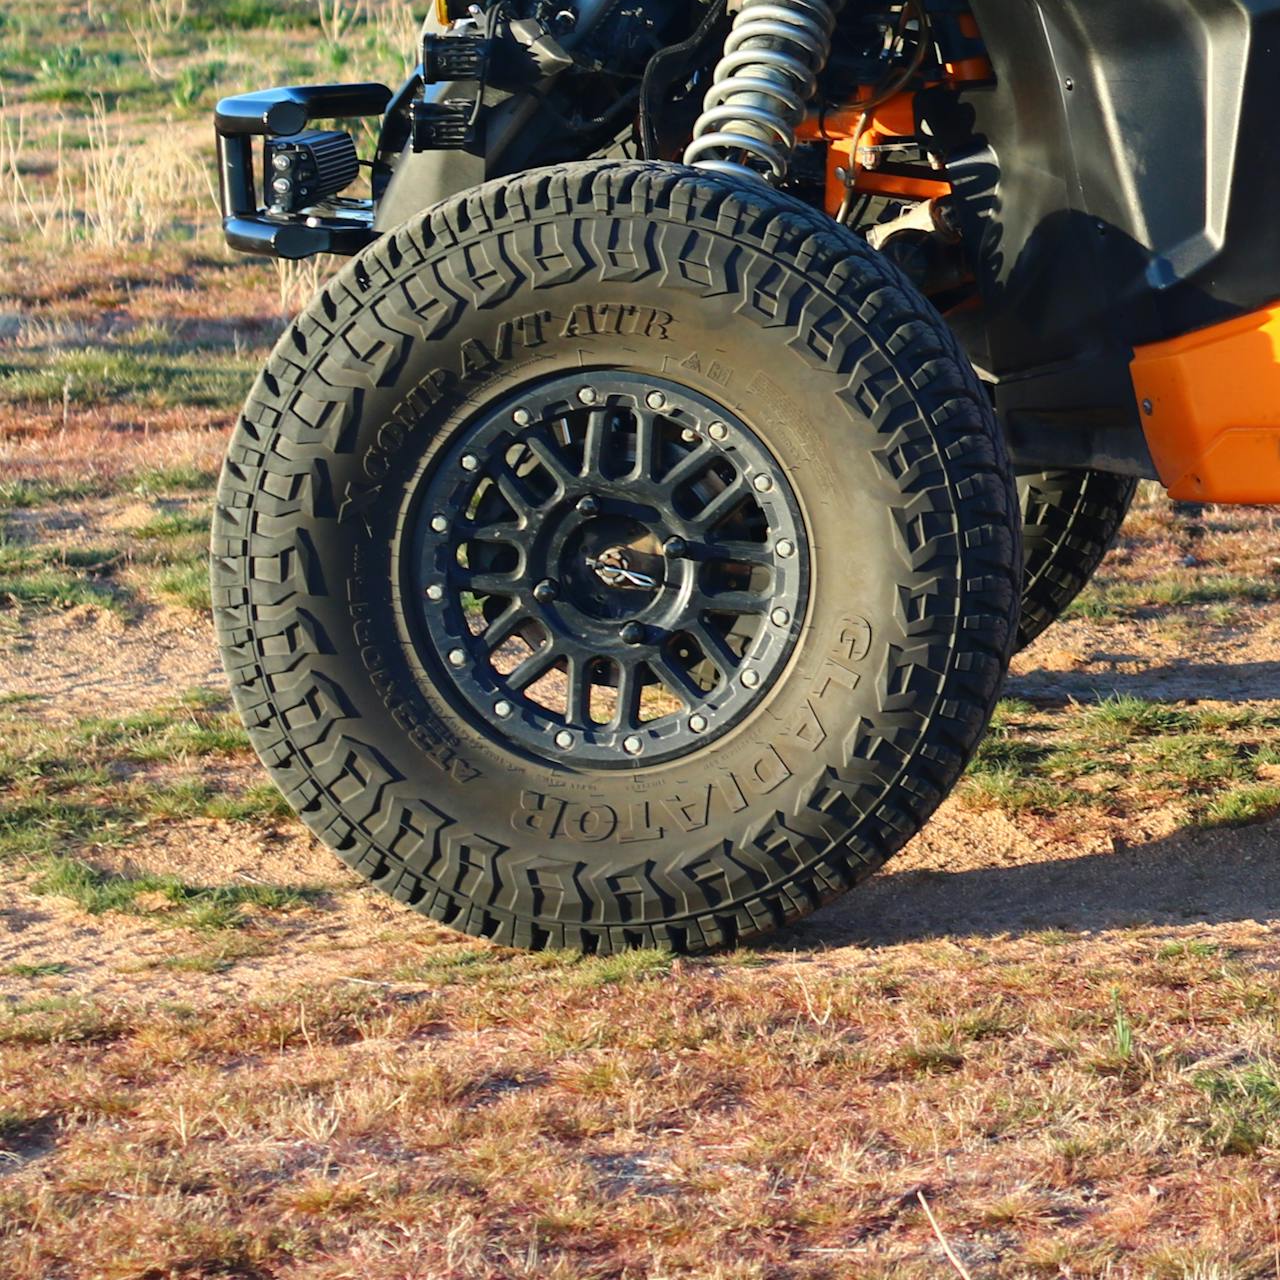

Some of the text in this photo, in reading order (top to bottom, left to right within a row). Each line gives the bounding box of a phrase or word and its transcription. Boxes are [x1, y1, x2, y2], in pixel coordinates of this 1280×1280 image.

[363, 367, 450, 480] COMP
[558, 301, 676, 340] ATR
[510, 615, 874, 844] GLADIATOR
